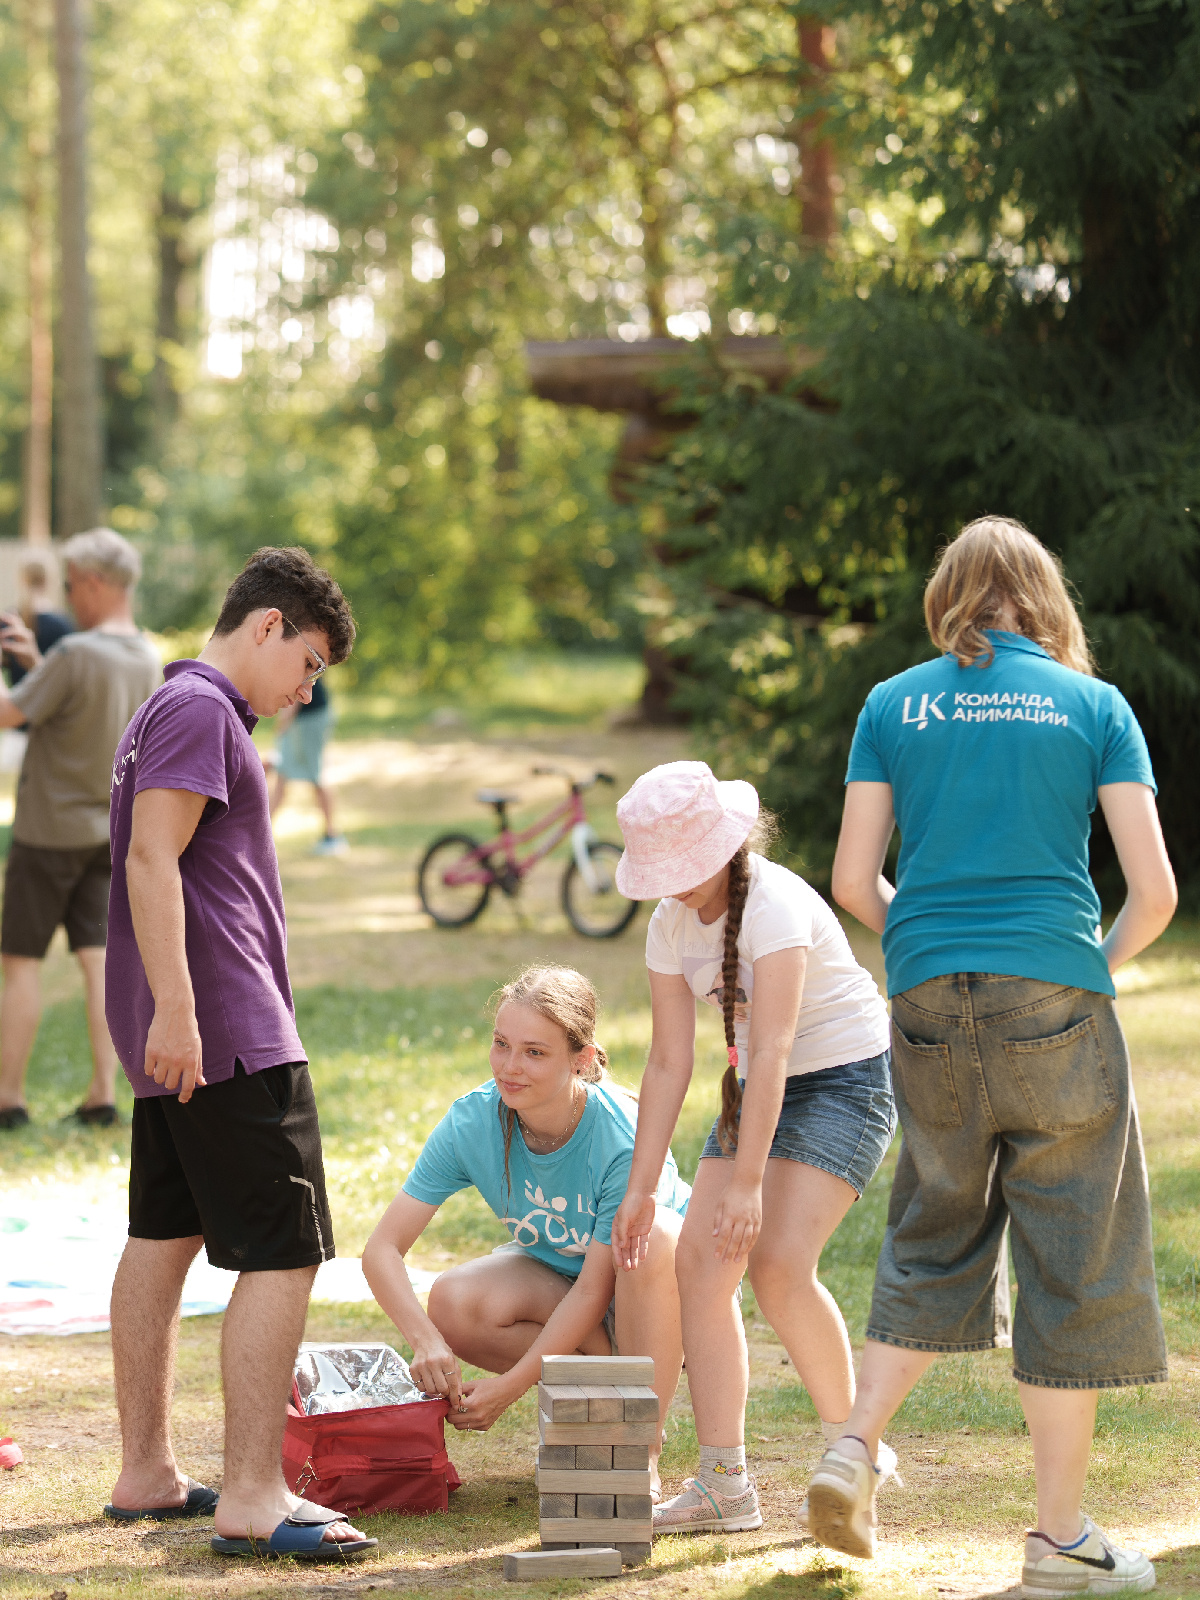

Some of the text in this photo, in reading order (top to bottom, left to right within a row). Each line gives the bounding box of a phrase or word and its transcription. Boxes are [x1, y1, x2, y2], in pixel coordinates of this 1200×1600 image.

[954, 692, 1055, 709] КОМАНДА
[902, 692, 946, 730] ЦК
[952, 707, 1069, 727] АНИМАЦИИ
